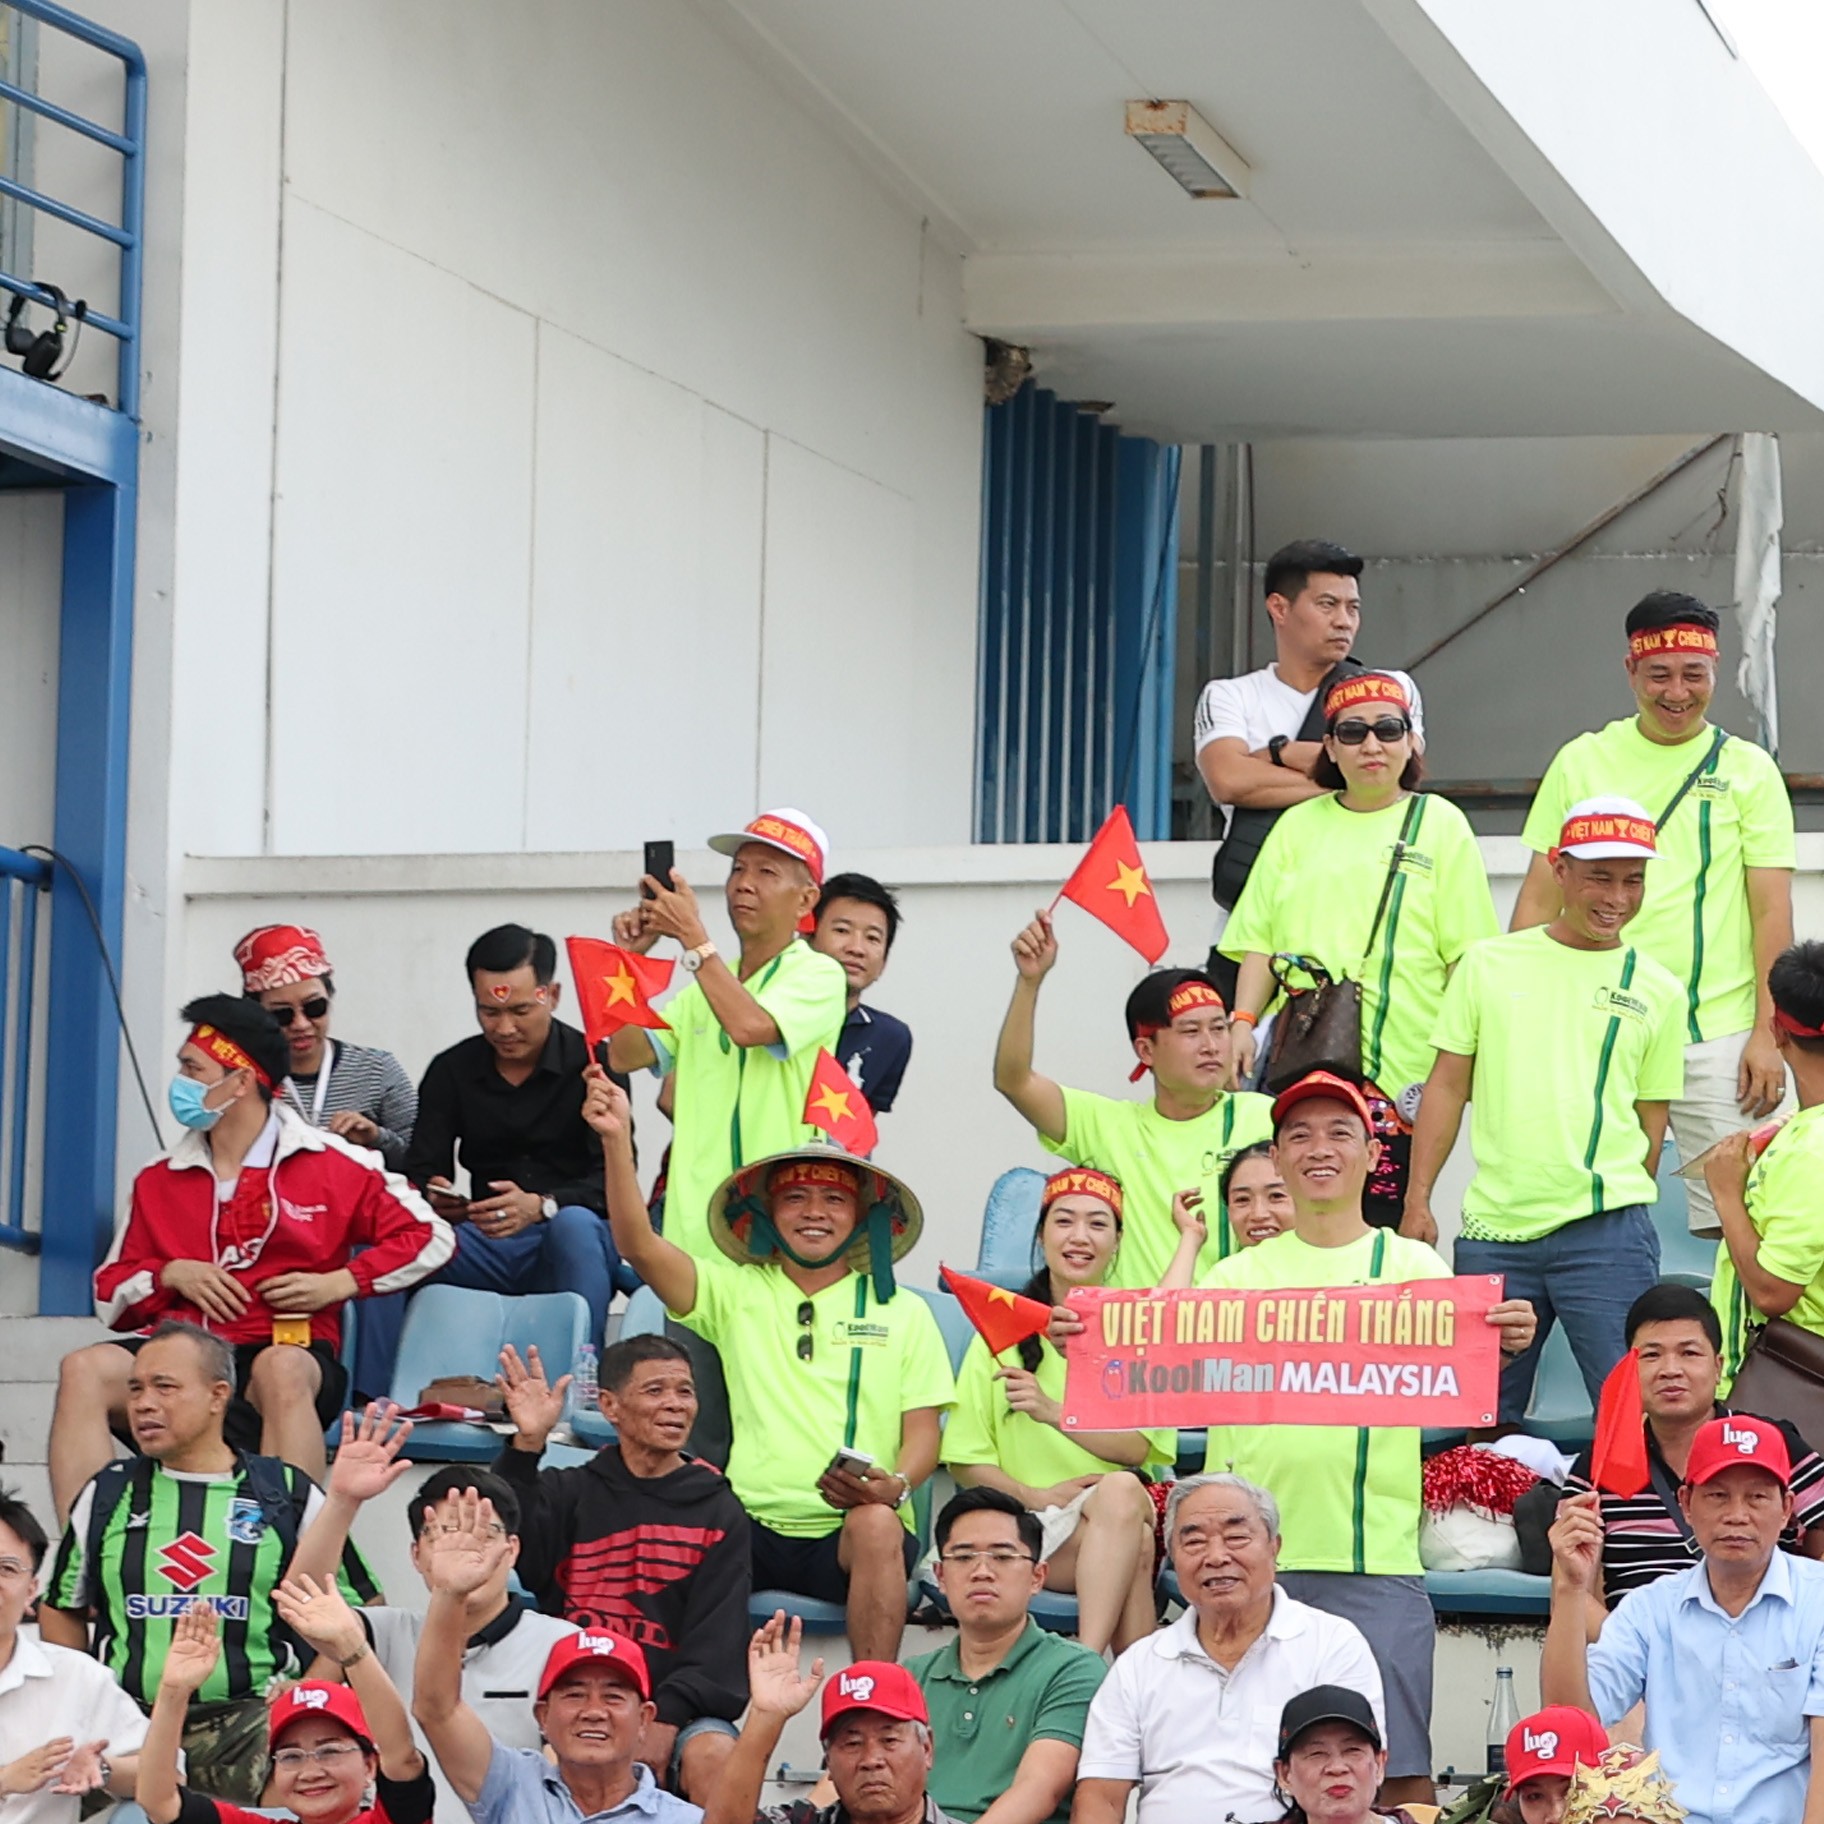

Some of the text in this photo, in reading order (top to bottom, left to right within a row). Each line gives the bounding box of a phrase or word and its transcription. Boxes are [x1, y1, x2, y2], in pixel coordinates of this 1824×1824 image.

[1177, 1301, 1245, 1344] NAM
[1359, 1288, 1455, 1347] THẮNG
[1128, 1357, 1460, 1397] KoolMan MALAYSIA
[1722, 1423, 1759, 1454] lug
[840, 1672, 875, 1701] lug
[1524, 1727, 1558, 1759] lug
